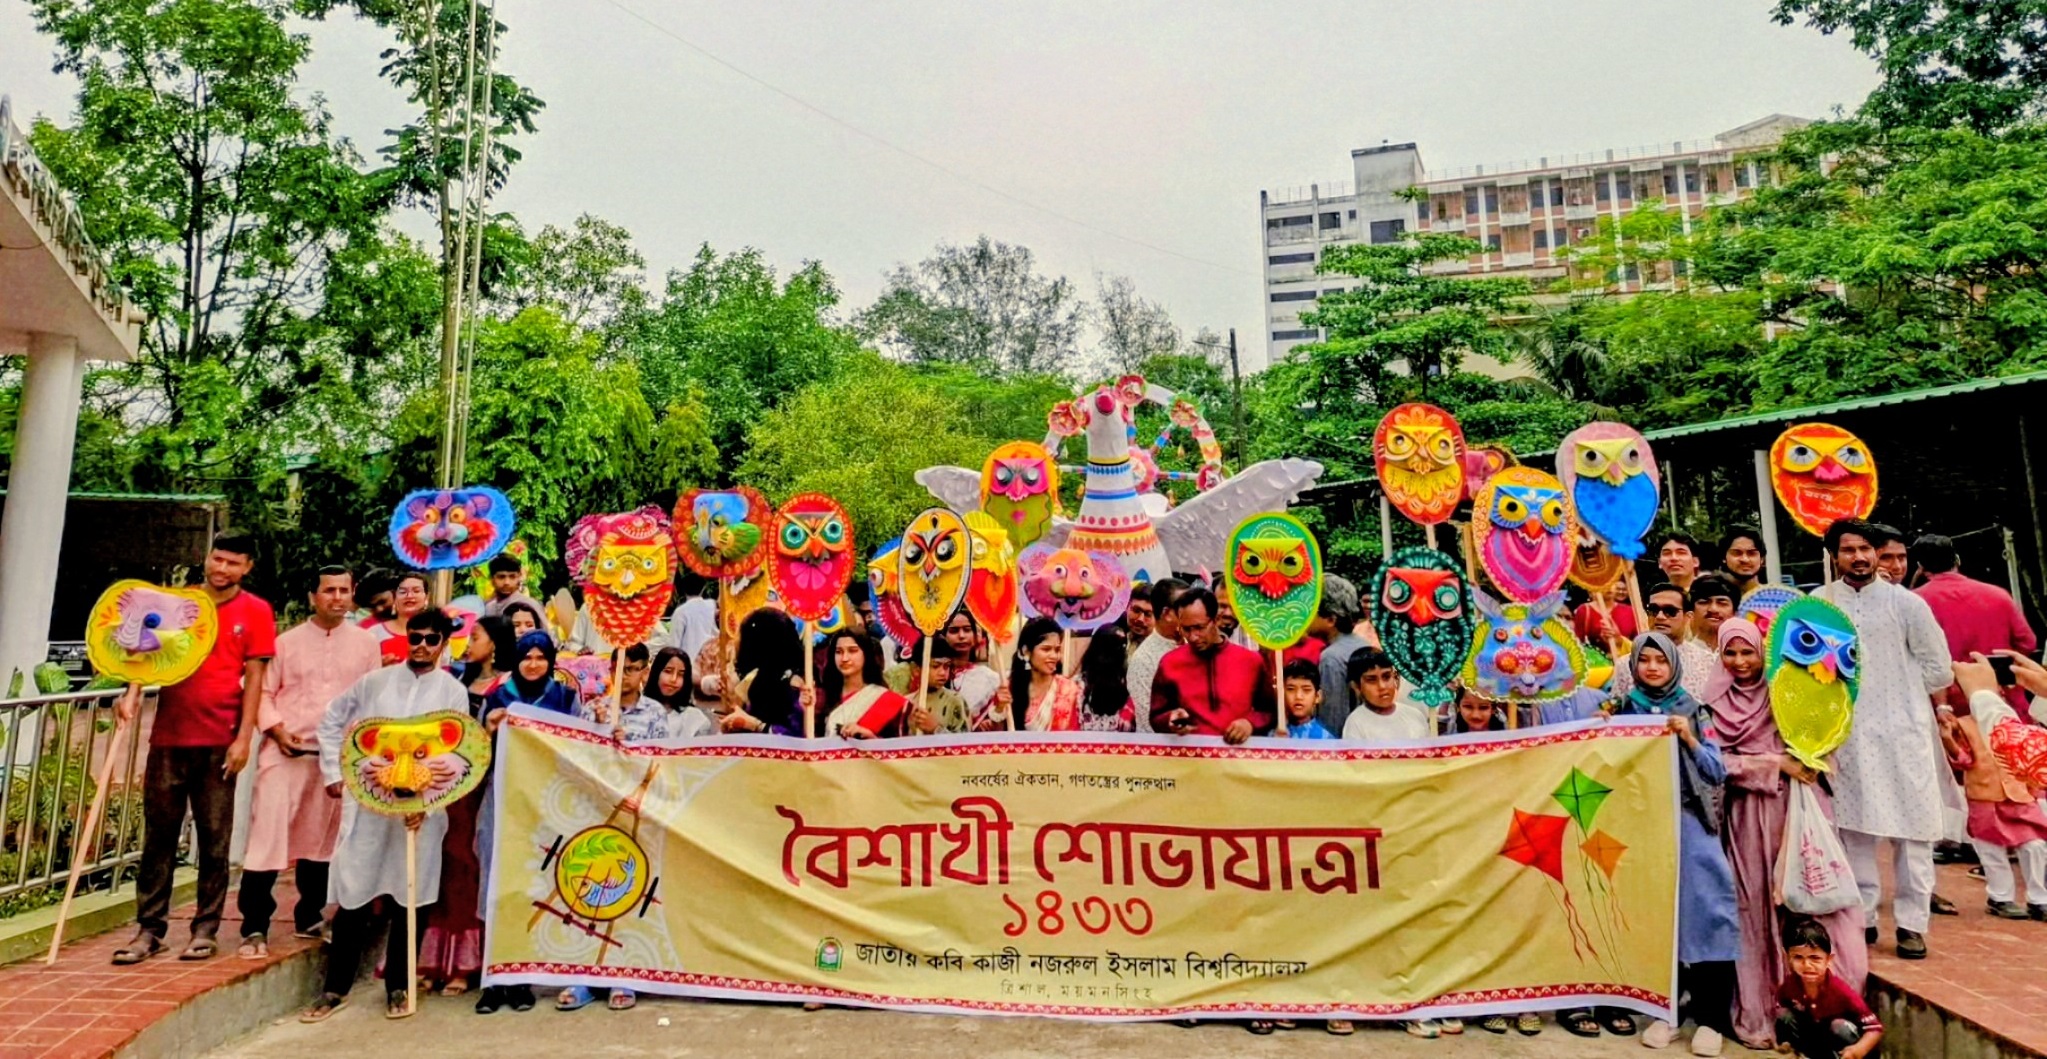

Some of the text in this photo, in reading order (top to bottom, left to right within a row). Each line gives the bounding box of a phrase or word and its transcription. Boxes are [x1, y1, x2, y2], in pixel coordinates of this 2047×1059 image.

[961, 770, 1009, 786] নববর্ষের
[1014, 770, 1064, 789] ঐকতান,
[1069, 773, 1119, 789] গণতন্ত্রের
[775, 796, 1383, 894] বৈশাখী শোভাযাত্রা
[1002, 890, 1153, 936] ১৪৩৩
[924, 948, 963, 971] কবি
[971, 946, 1021, 974] কাজী
[1028, 954, 1098, 976] নজরুল
[1106, 949, 1177, 978] ইসলাম
